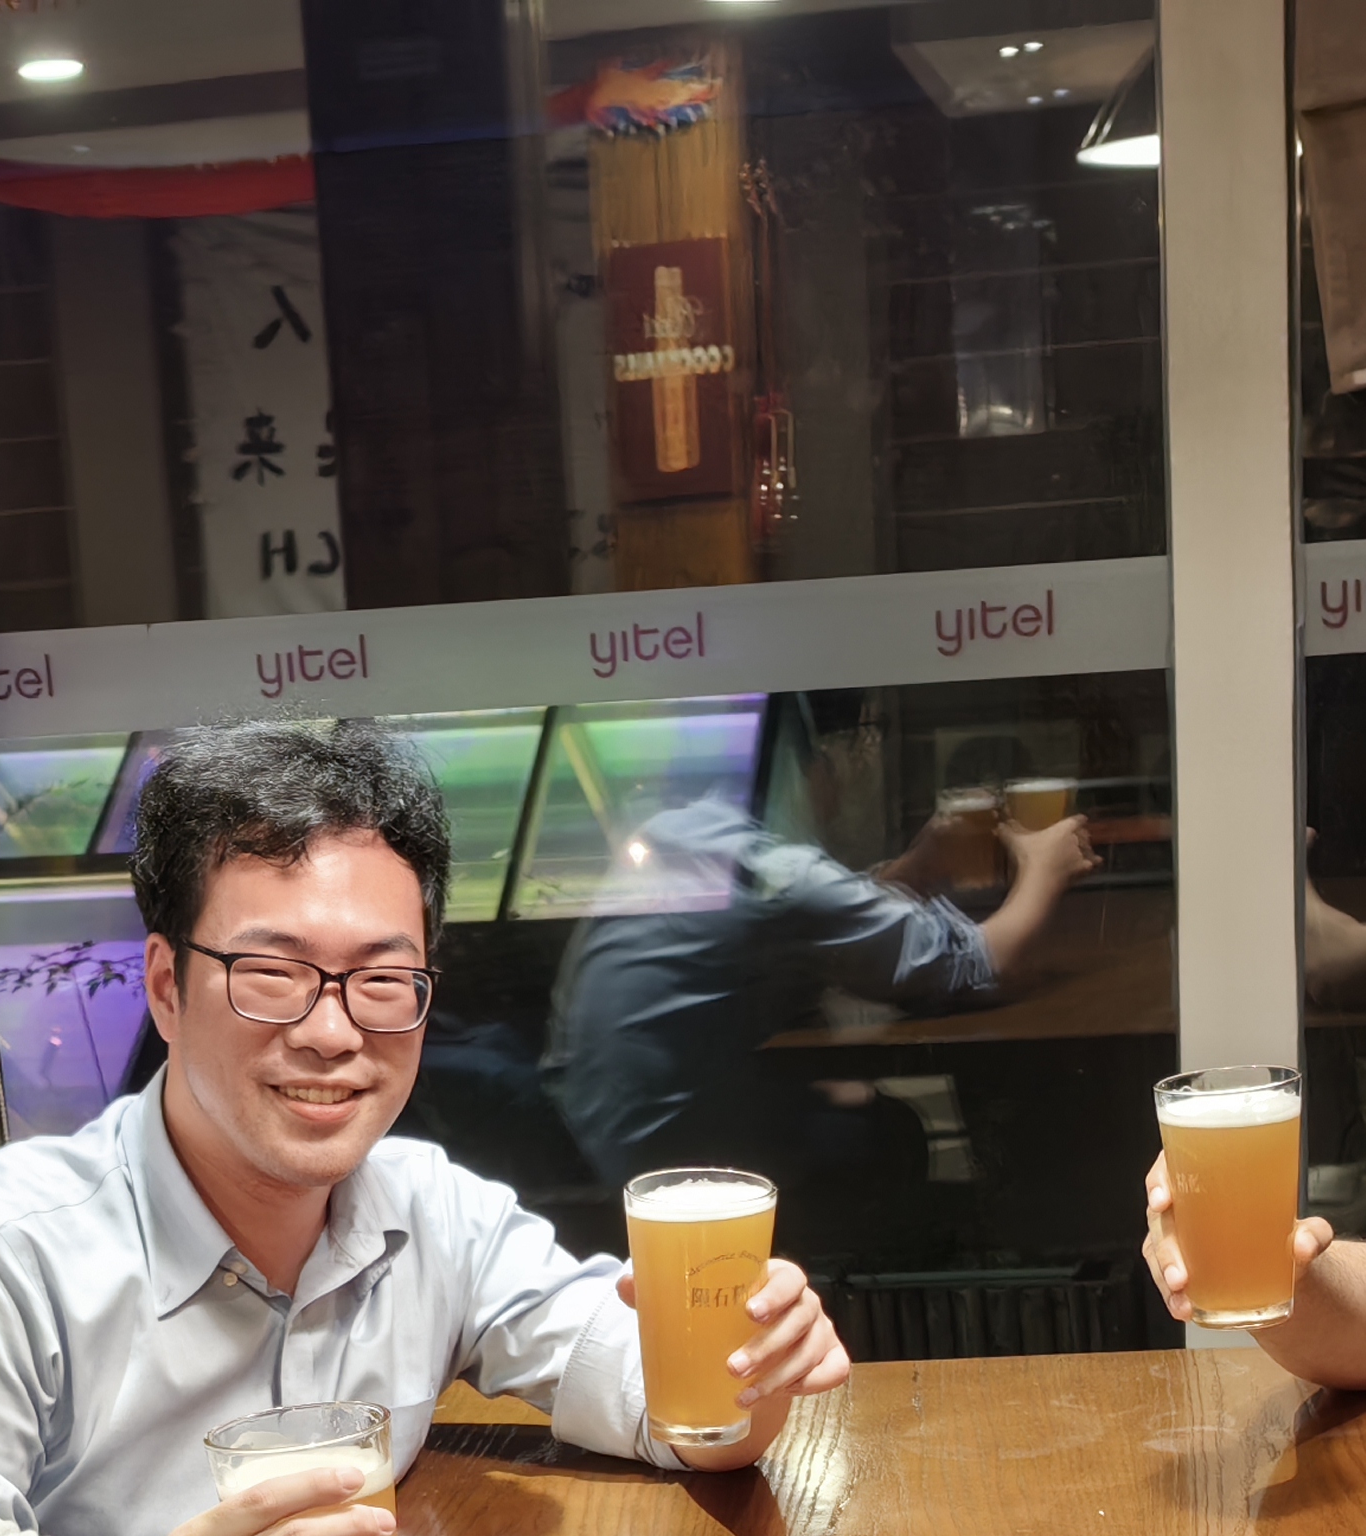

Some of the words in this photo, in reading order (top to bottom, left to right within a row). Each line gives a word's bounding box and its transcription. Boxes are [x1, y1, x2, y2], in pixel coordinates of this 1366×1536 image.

[255, 633, 369, 700] yitel
[589, 611, 707, 679] yitel
[934, 588, 1055, 657] yitel
